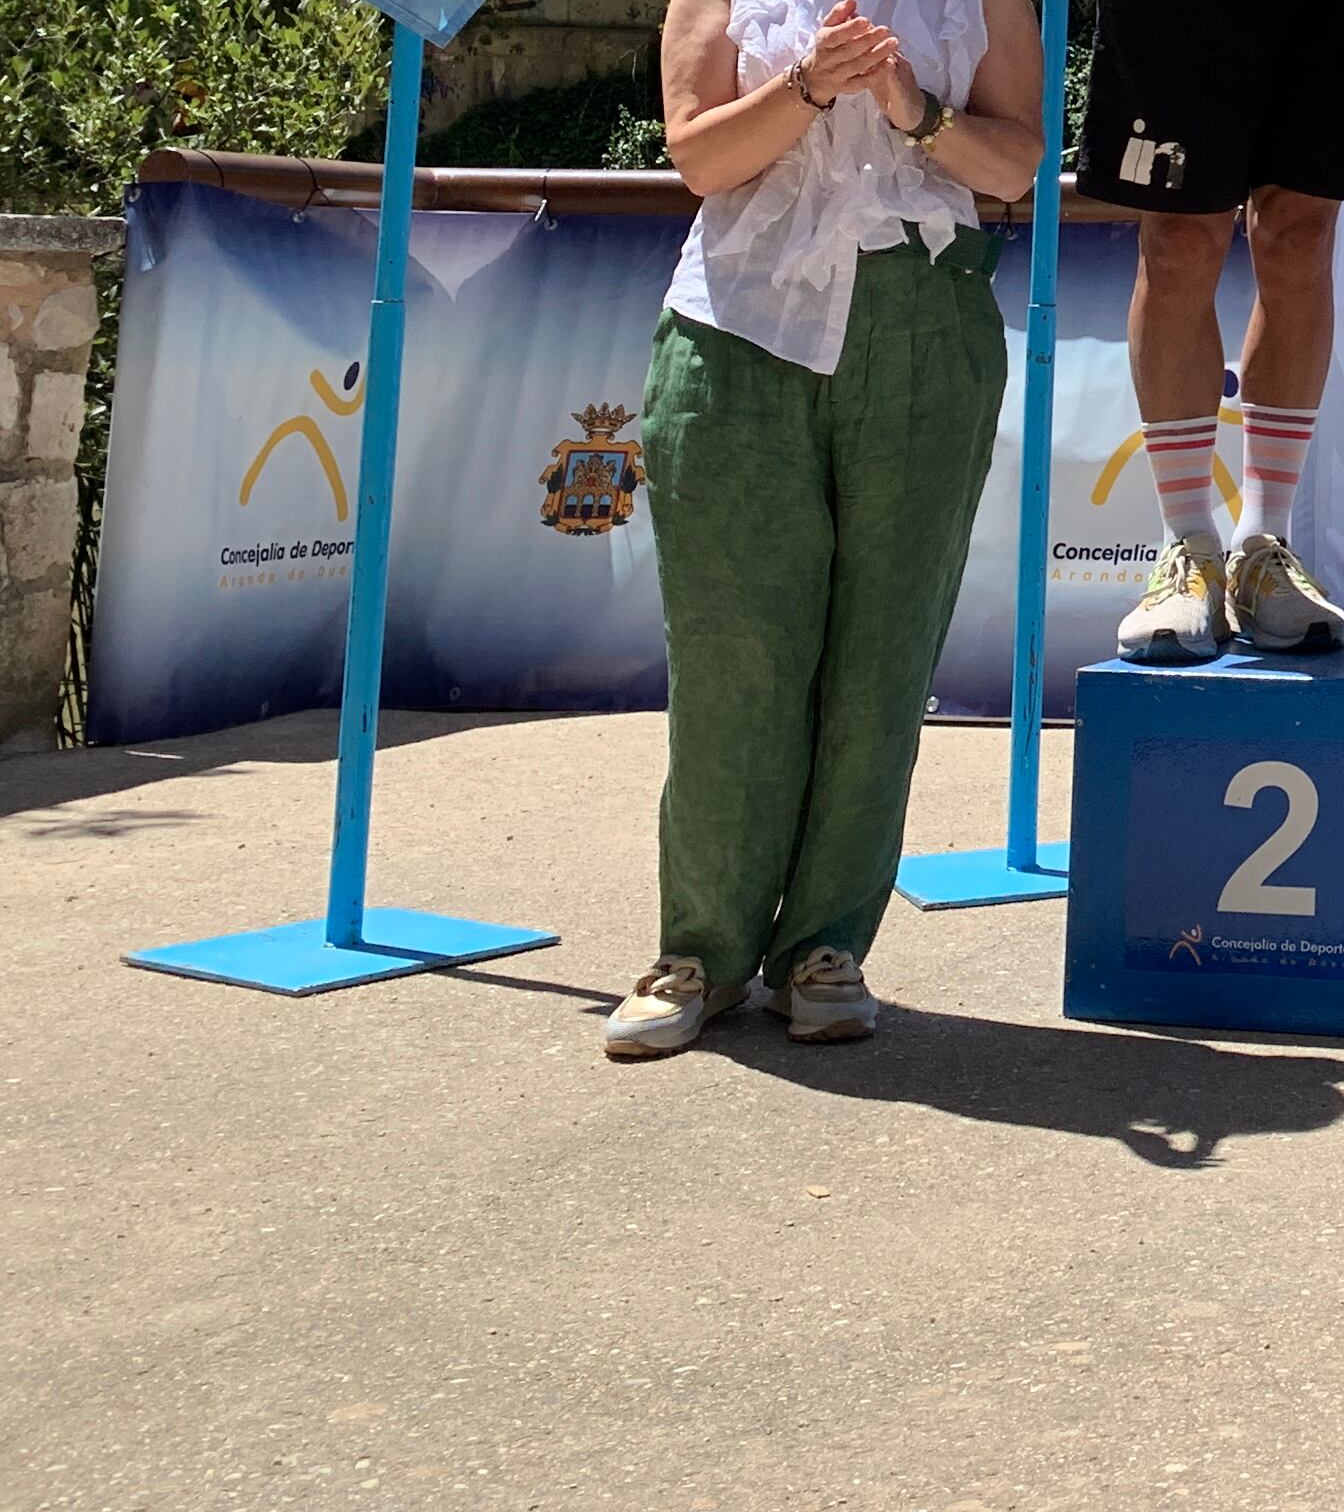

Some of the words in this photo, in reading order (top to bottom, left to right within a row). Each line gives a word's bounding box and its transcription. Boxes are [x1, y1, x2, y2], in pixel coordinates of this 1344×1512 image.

[290, 541, 306, 559] de
[311, 540, 355, 561] Depor
[317, 566, 348, 578] Due
[1216, 760, 1319, 916] 2
[1280, 940, 1297, 952] de
